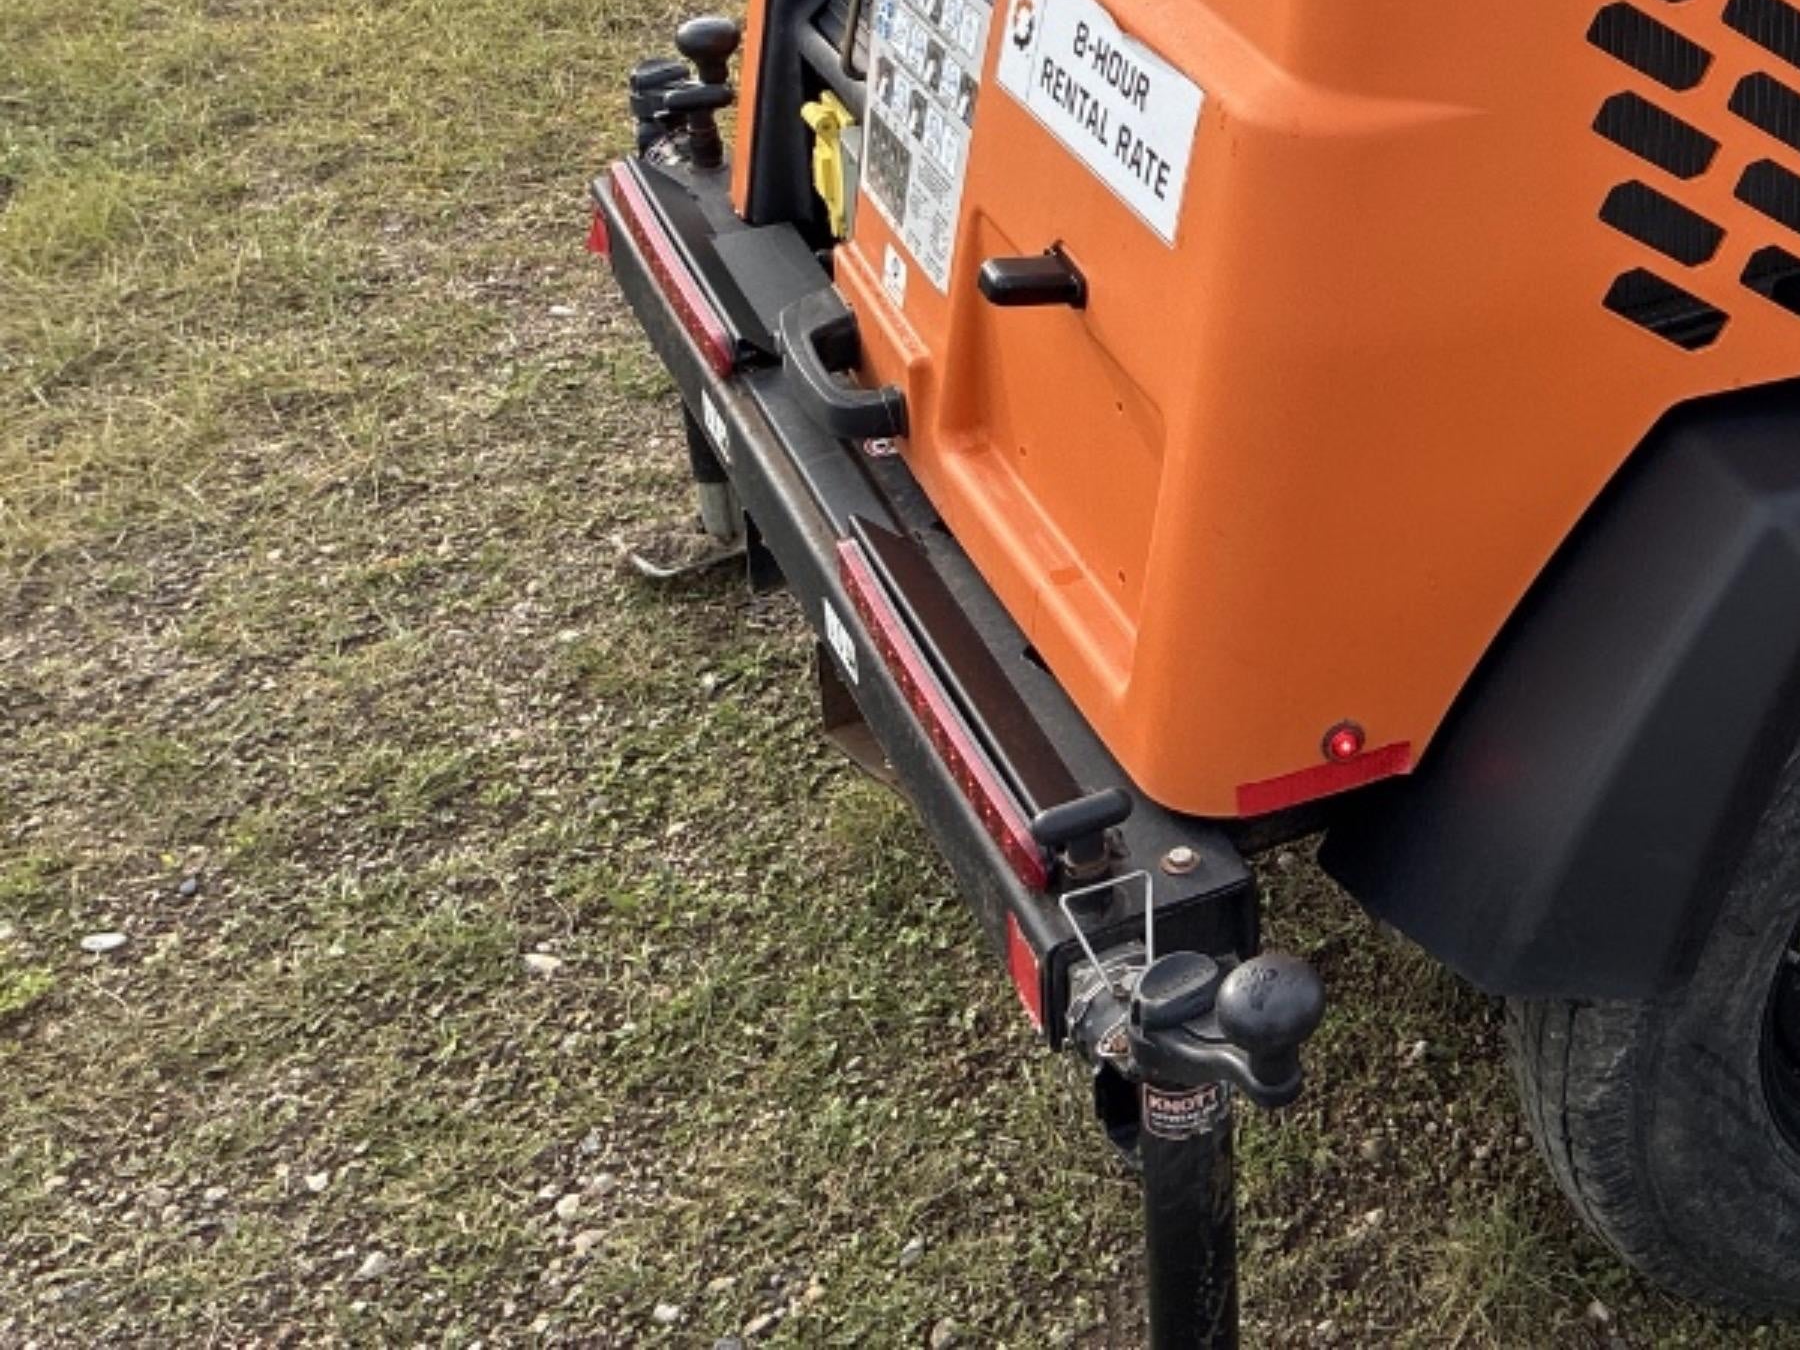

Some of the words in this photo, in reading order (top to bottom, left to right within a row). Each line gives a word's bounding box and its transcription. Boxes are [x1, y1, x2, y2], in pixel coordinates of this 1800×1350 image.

[1072, 20, 1151, 113] 8-HOUR
[1039, 56, 1108, 148] RENTAL
[1113, 122, 1171, 202] RATE
